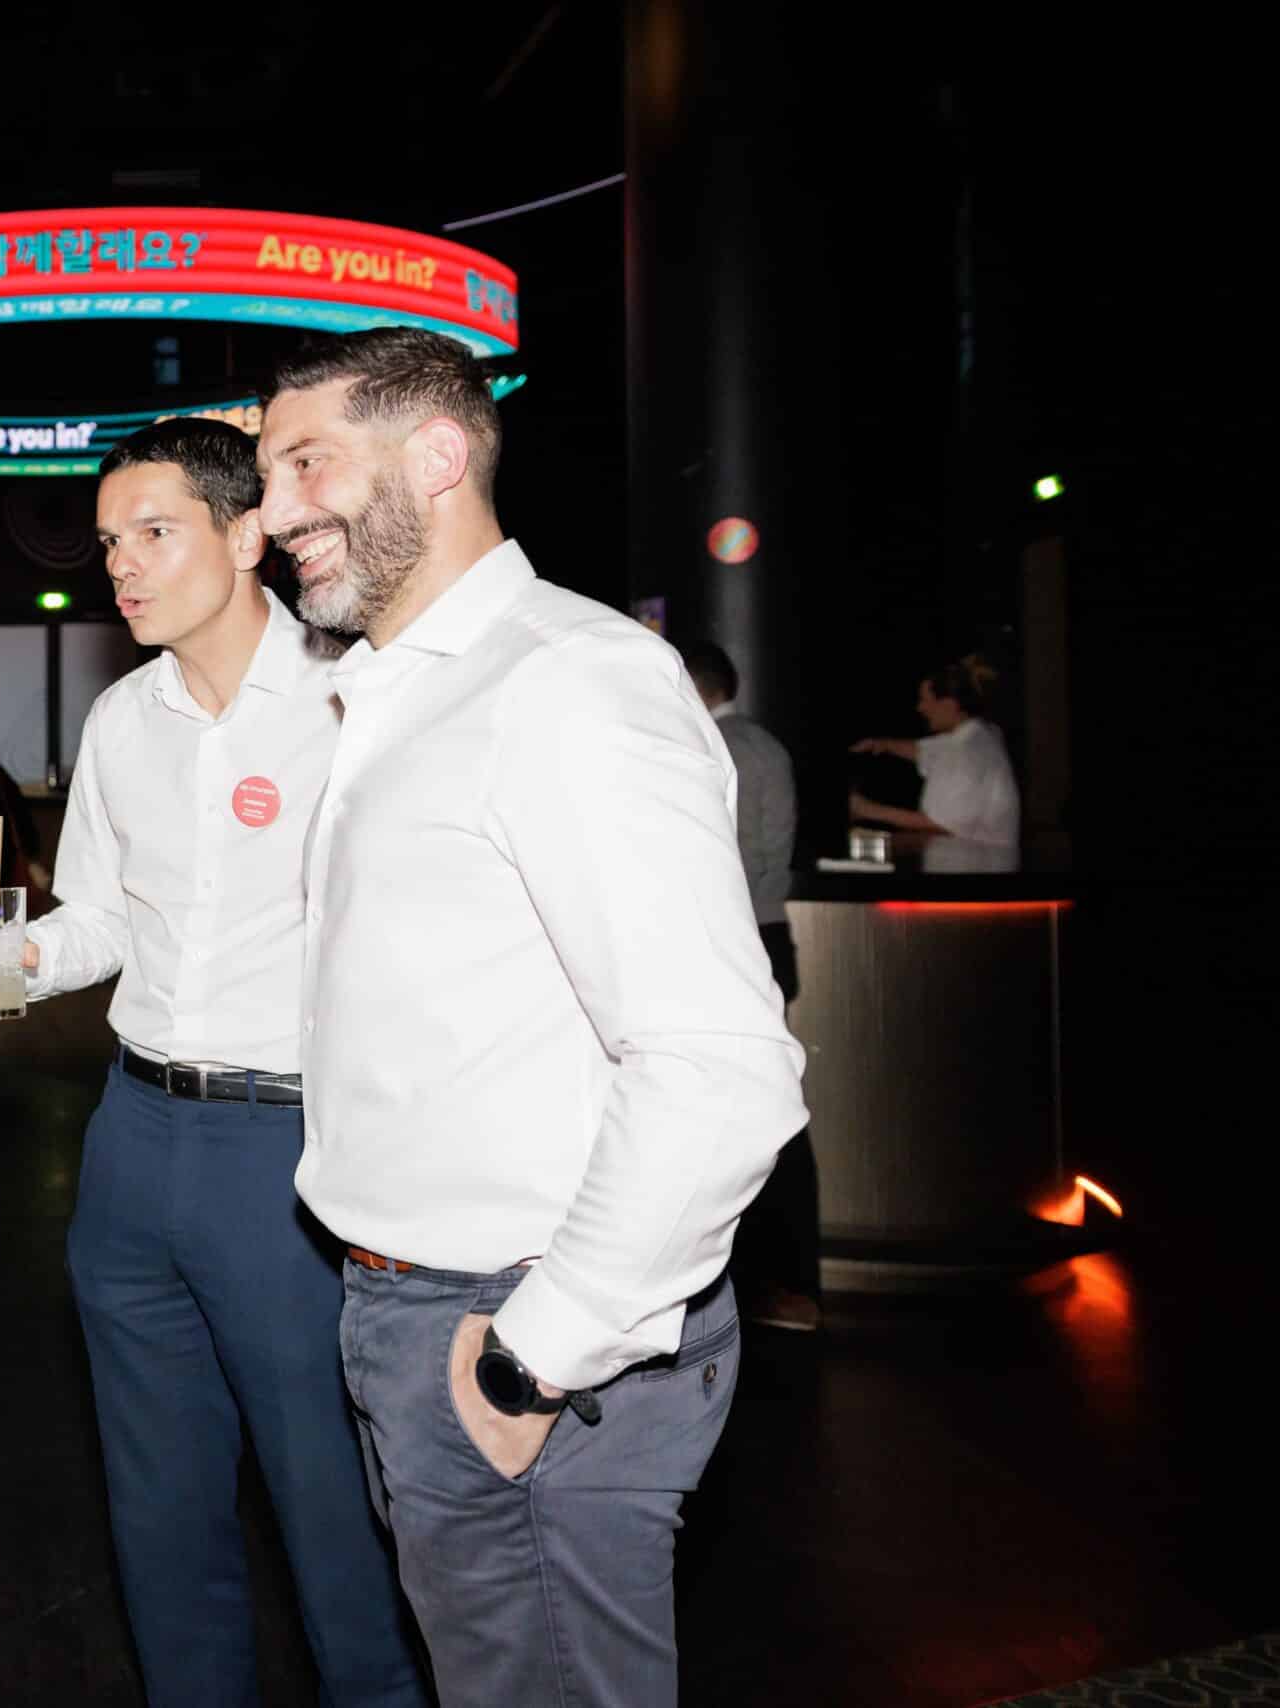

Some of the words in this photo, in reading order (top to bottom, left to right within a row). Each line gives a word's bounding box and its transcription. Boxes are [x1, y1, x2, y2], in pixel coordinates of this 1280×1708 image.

[256, 233, 322, 273] Are
[328, 247, 391, 283] you
[394, 249, 437, 291] in?
[7, 426, 55, 454] you
[55, 421, 97, 449] in?
